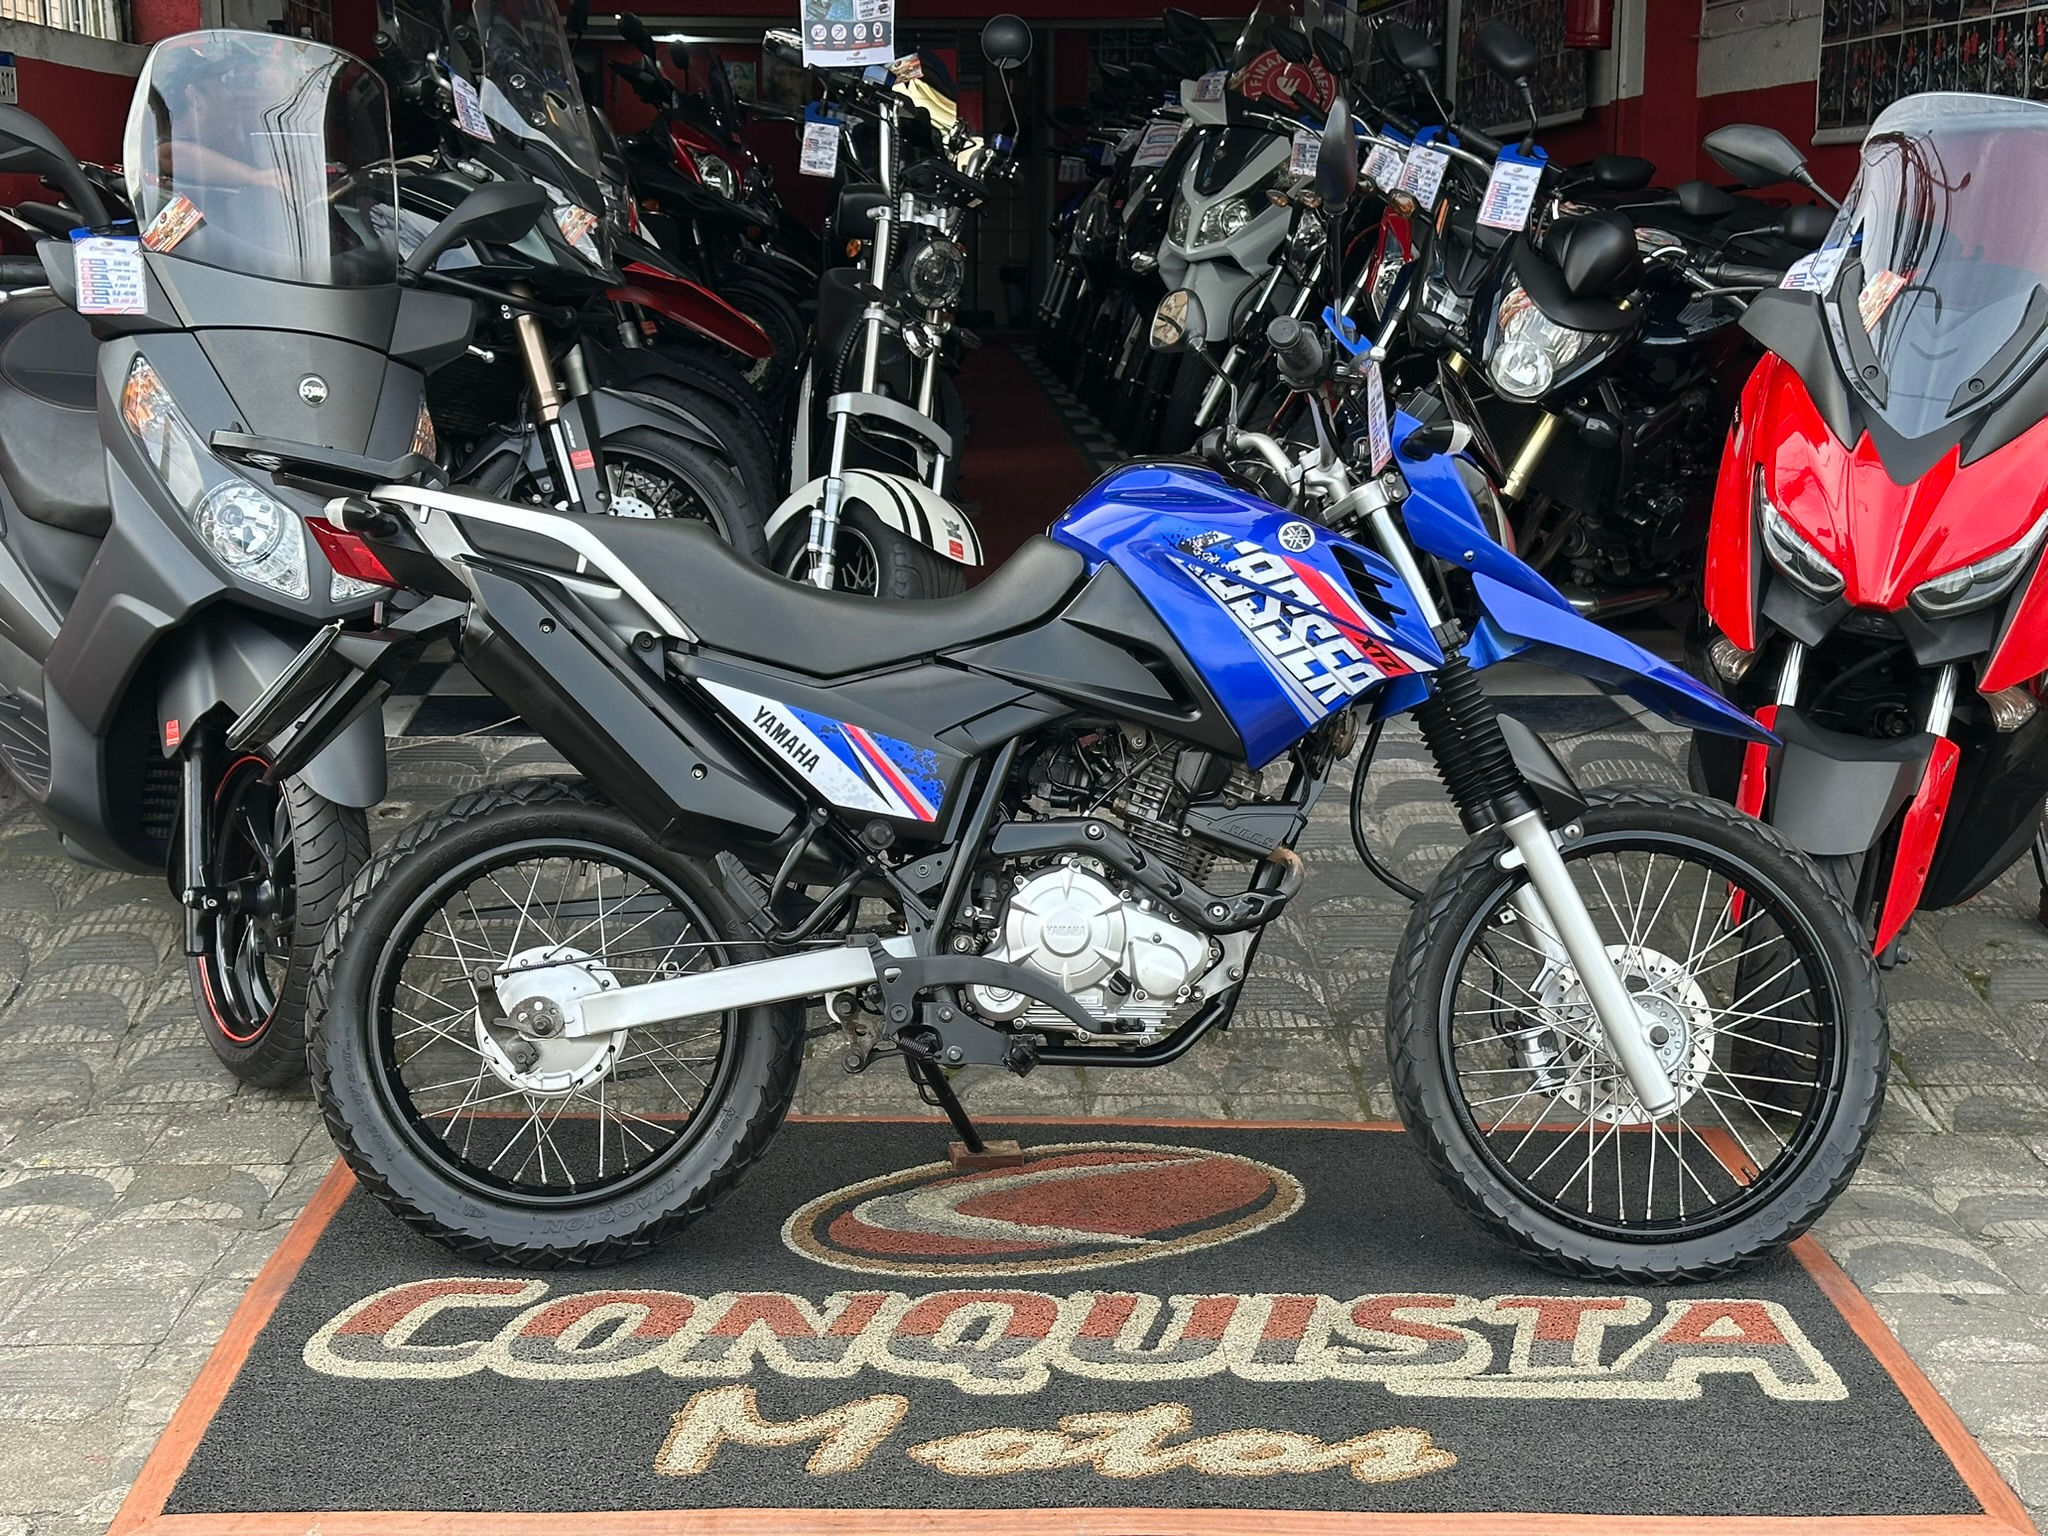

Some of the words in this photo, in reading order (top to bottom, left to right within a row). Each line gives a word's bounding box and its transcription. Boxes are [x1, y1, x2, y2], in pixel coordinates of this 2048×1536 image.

[1356, 636, 1403, 672] XTZ
[752, 704, 821, 774] YAMAHA
[302, 1278, 1850, 1403] CONQUISTA
[653, 1384, 1457, 1483] Motos
